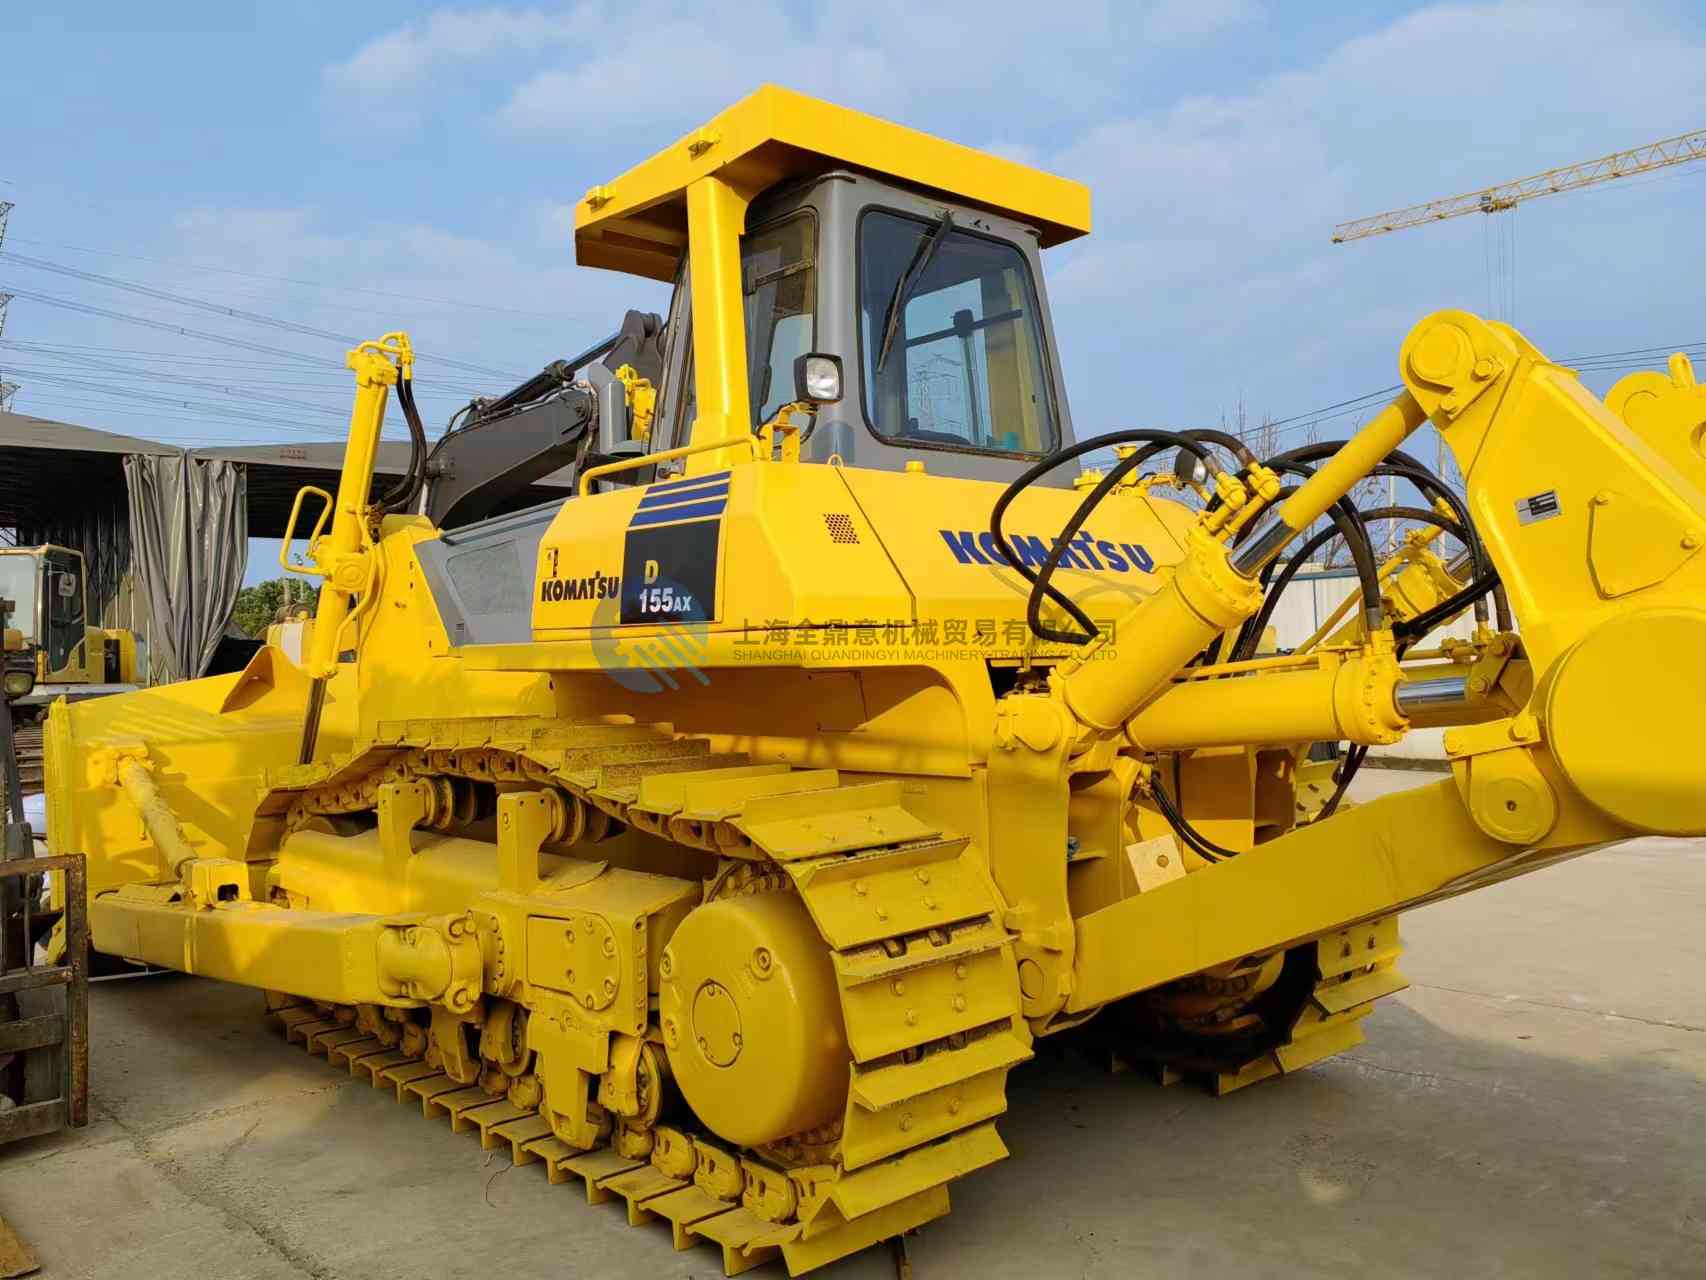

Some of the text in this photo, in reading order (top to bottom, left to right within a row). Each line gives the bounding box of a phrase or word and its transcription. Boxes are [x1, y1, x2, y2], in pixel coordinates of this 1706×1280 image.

[939, 530, 1155, 575] KOMATSU
[541, 571, 619, 602] KOMATSU
[644, 559, 659, 585] D
